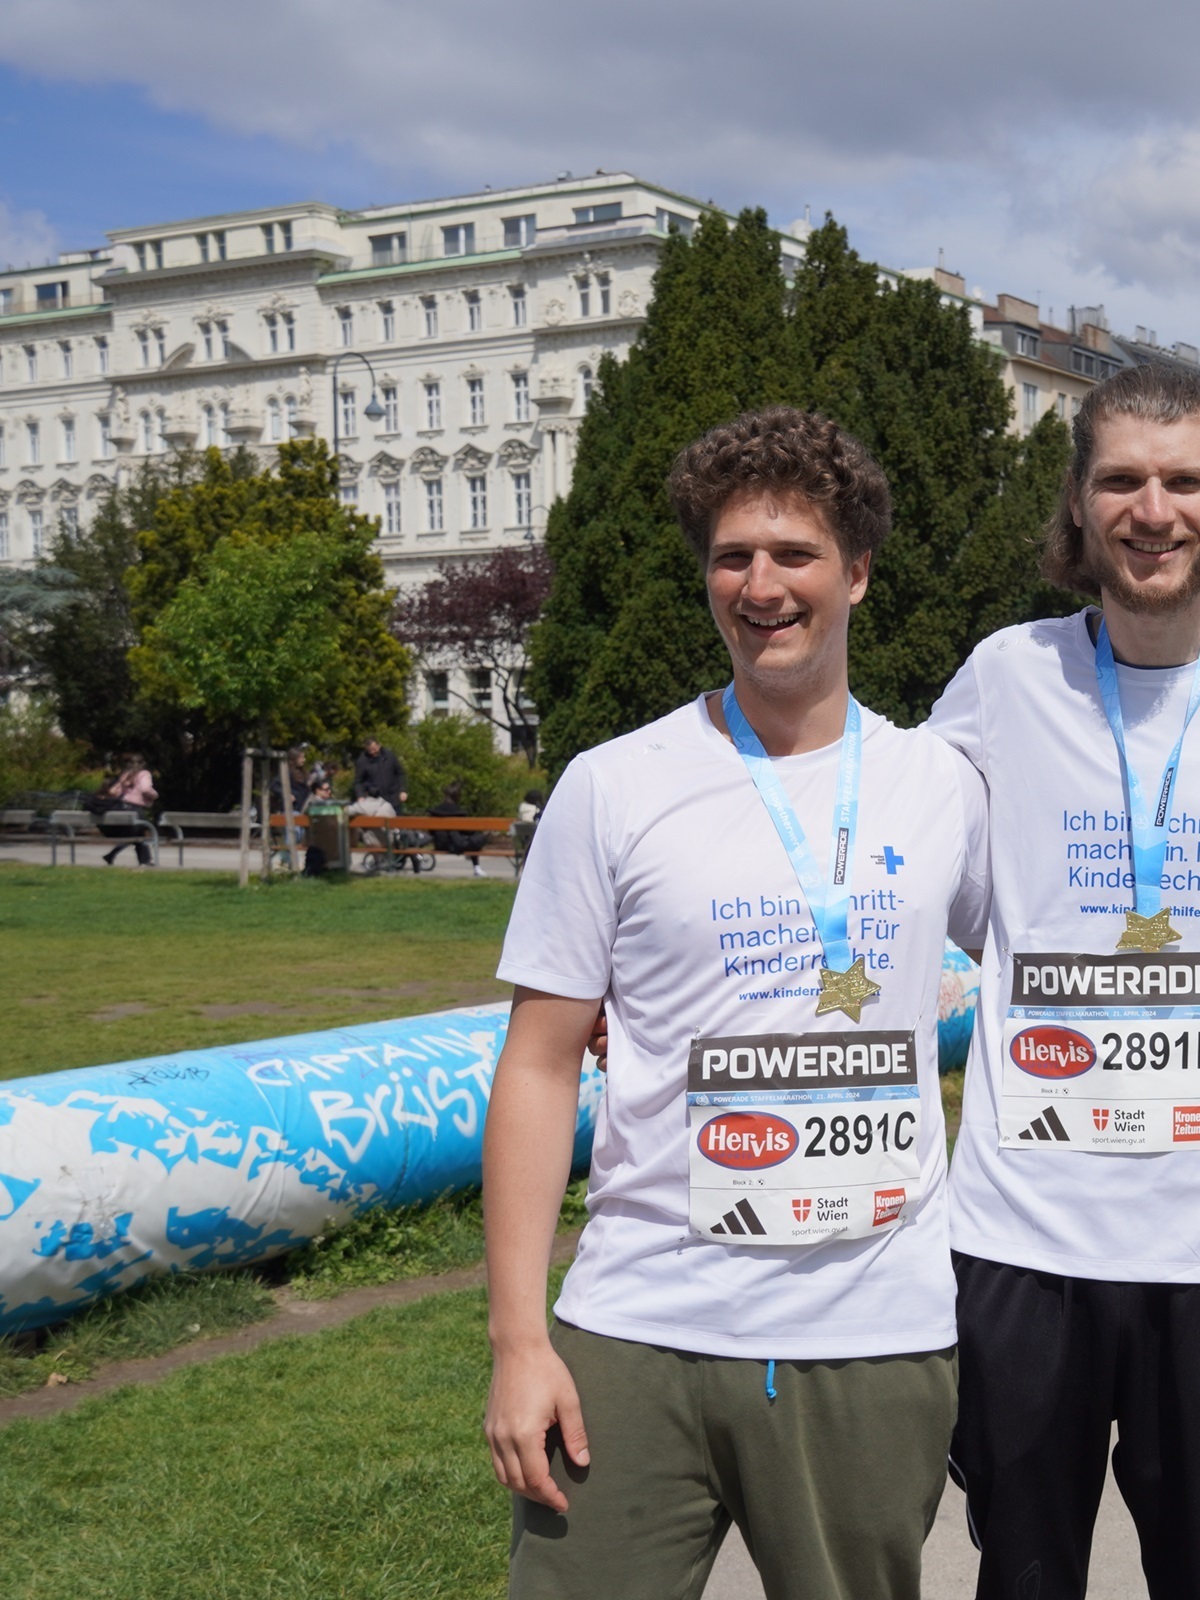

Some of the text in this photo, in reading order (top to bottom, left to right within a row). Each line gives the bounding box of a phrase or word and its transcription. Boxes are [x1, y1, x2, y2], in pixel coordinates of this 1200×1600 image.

[1063, 810, 1095, 831] Ich
[835, 829, 848, 884] POWERADE
[711, 896, 751, 921] Ich
[760, 894, 801, 918] bin
[860, 918, 900, 940] Für
[247, 1027, 491, 1087] CAPTAIN
[1019, 1036, 1090, 1068] Hervis
[750, 1094, 812, 1102] STAFFELMARATHON
[1114, 1109, 1145, 1120] Stadt
[708, 1111, 916, 1158] Hervis 2891C
[1114, 1121, 1145, 1132] Wien
[1091, 1137, 1146, 1145] sport.wien.gv.at
[817, 1194, 905, 1209] Stadt Kronen
[817, 1210, 849, 1221] Wien
